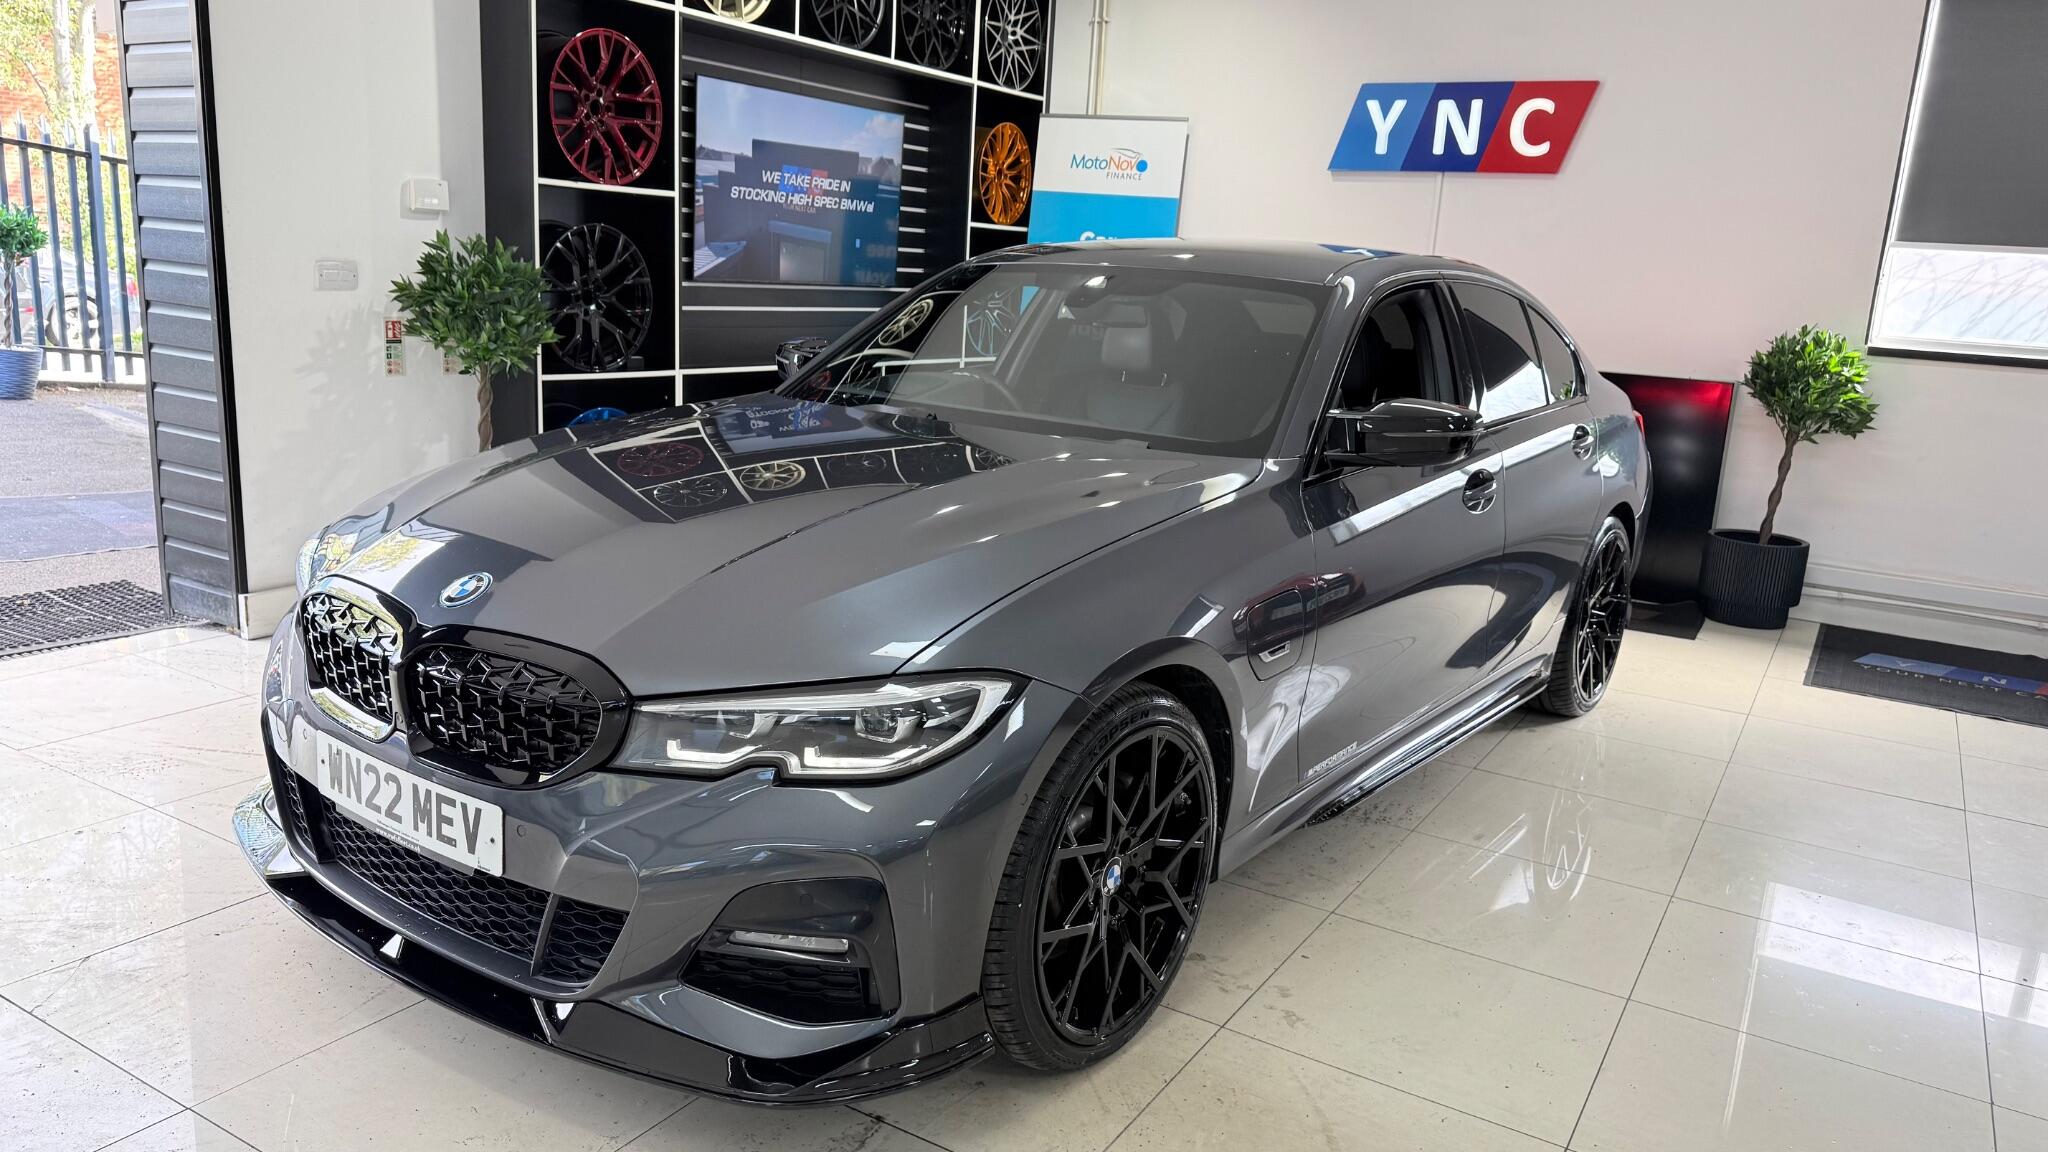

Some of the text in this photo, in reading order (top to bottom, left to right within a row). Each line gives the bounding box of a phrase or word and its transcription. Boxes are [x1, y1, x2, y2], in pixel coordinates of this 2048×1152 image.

[1366, 97, 1556, 158] YNC
[762, 169, 851, 193] WE TAKE PRIDE IN
[1106, 172, 1142, 181] FINANCE
[730, 186, 786, 203] STOCKING
[787, 193, 813, 207] HIGH
[813, 195, 839, 209] SPEC
[328, 742, 483, 856] WN22 MEV
